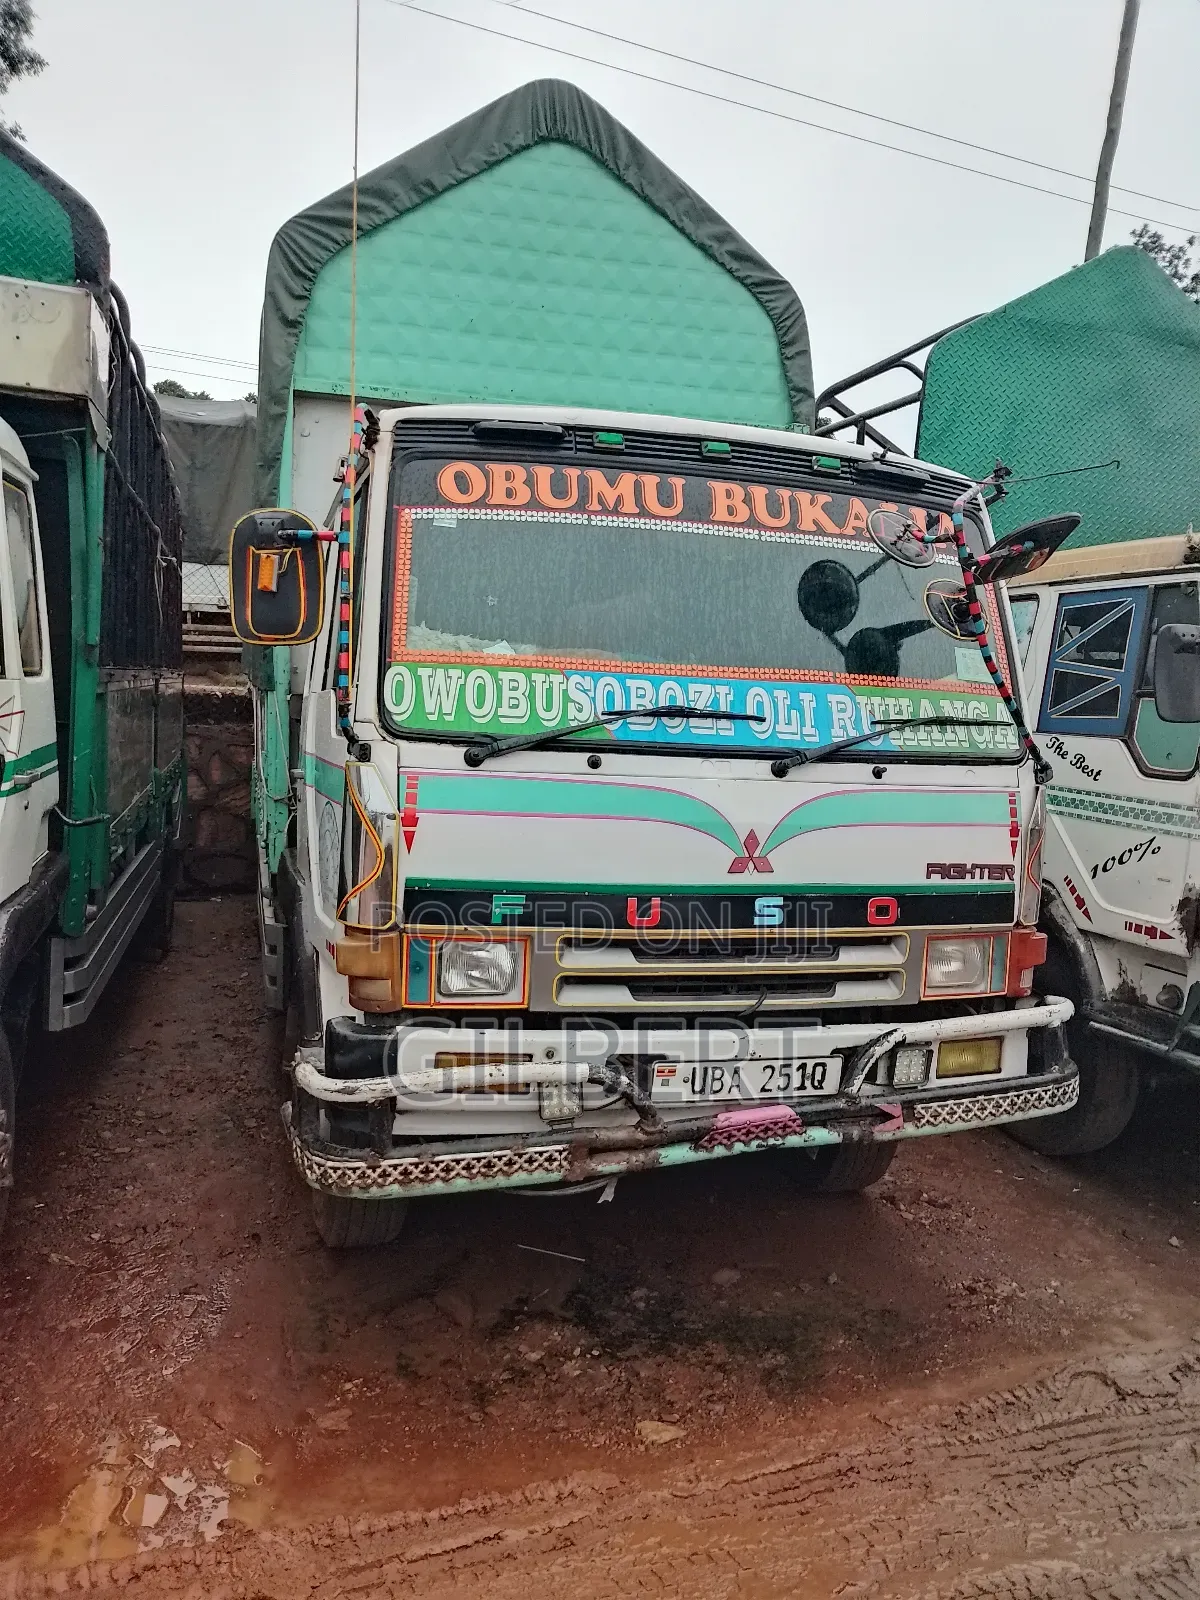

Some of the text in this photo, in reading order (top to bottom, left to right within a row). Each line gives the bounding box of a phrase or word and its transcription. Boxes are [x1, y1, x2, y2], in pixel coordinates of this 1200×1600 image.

[437, 461, 686, 517] OBUMU
[383, 665, 1019, 749] OWOBUSOBOZI OLI RUHANGA
[1045, 736, 1102, 782] The Best
[926, 862, 1016, 881] FIGHTER
[1090, 836, 1162, 880] 100%
[491, 894, 899, 927] FUSO
[690, 1061, 828, 1095] UBA 251Q
